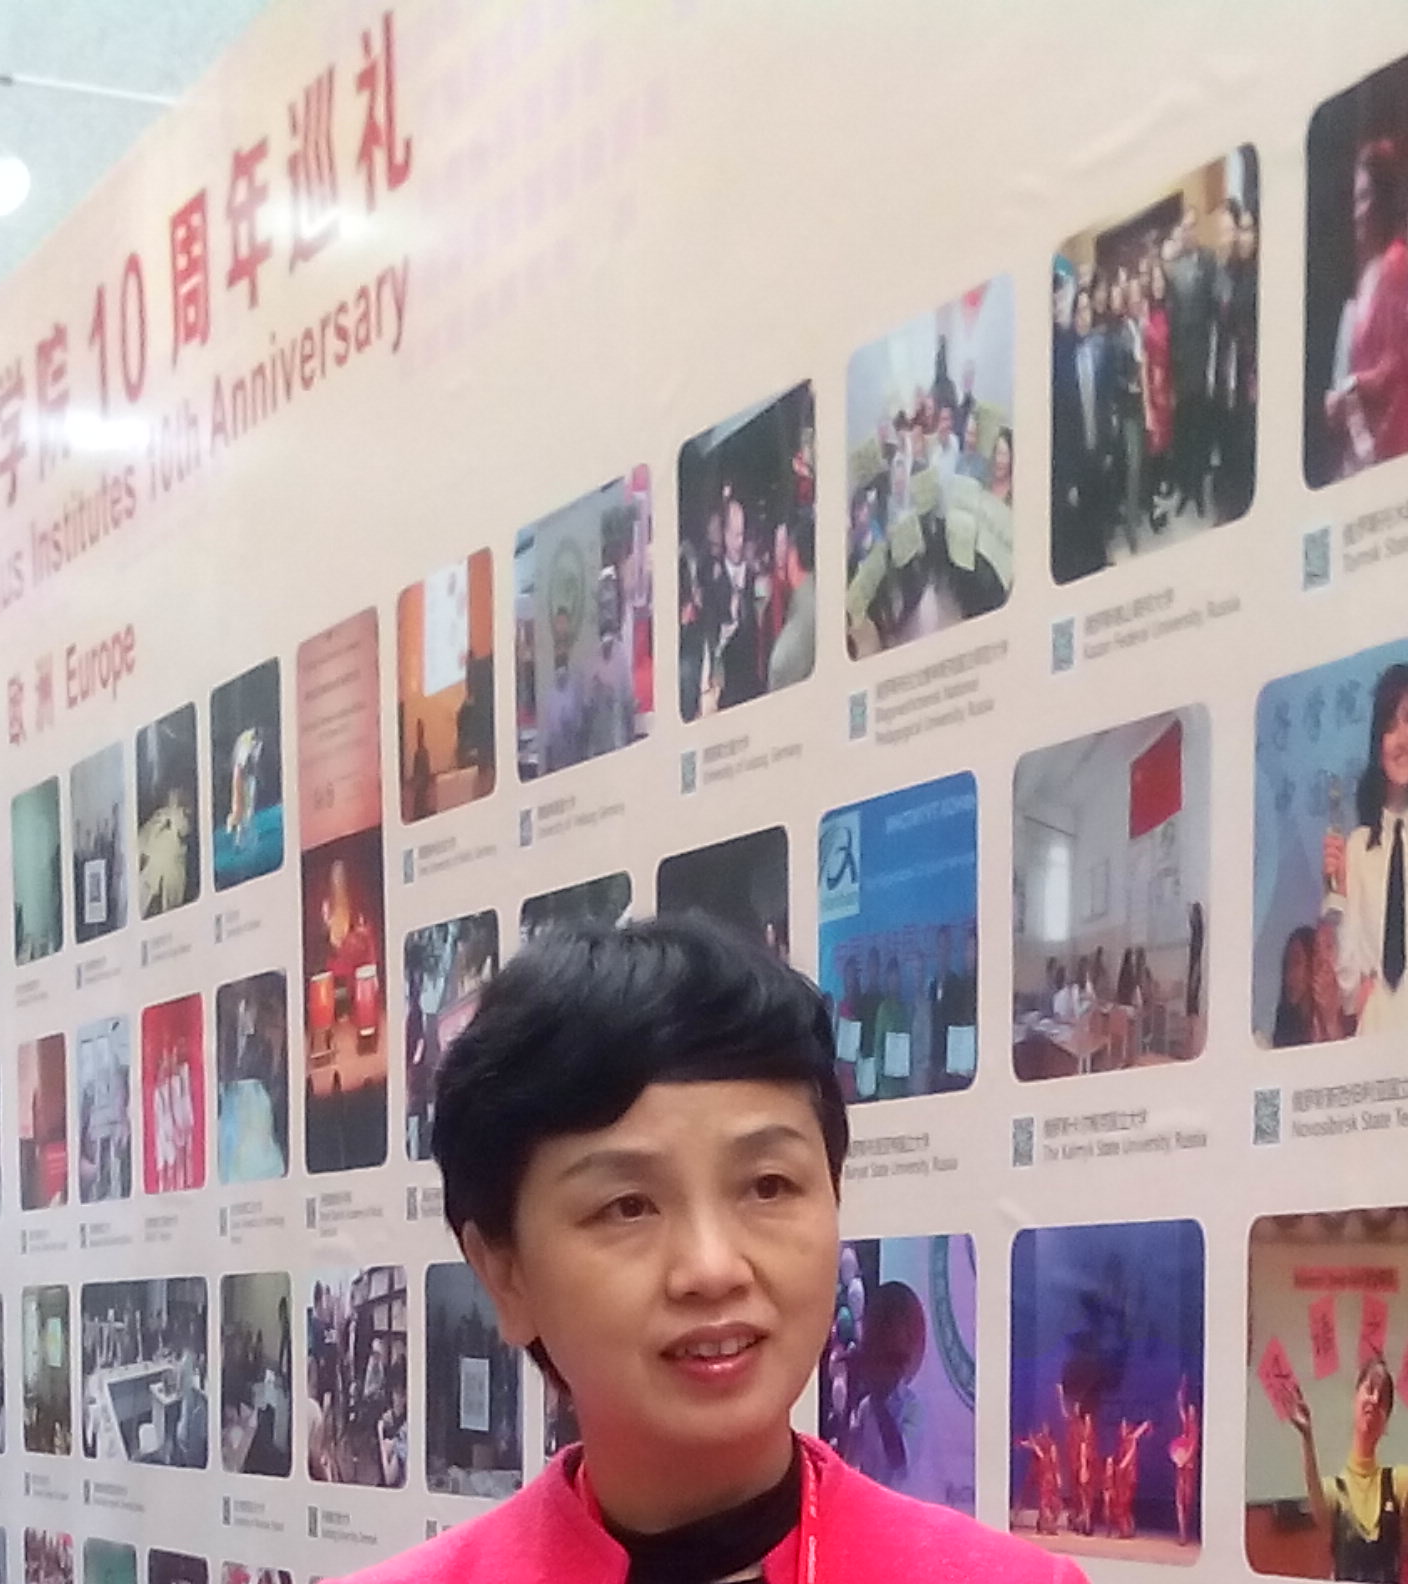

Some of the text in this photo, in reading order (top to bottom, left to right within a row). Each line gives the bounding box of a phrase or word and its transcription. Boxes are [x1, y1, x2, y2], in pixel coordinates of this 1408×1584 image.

[168, 9, 413, 370] 周年巡礼
[210, 254, 408, 458] Anniversary
[65, 622, 136, 711] Europe
